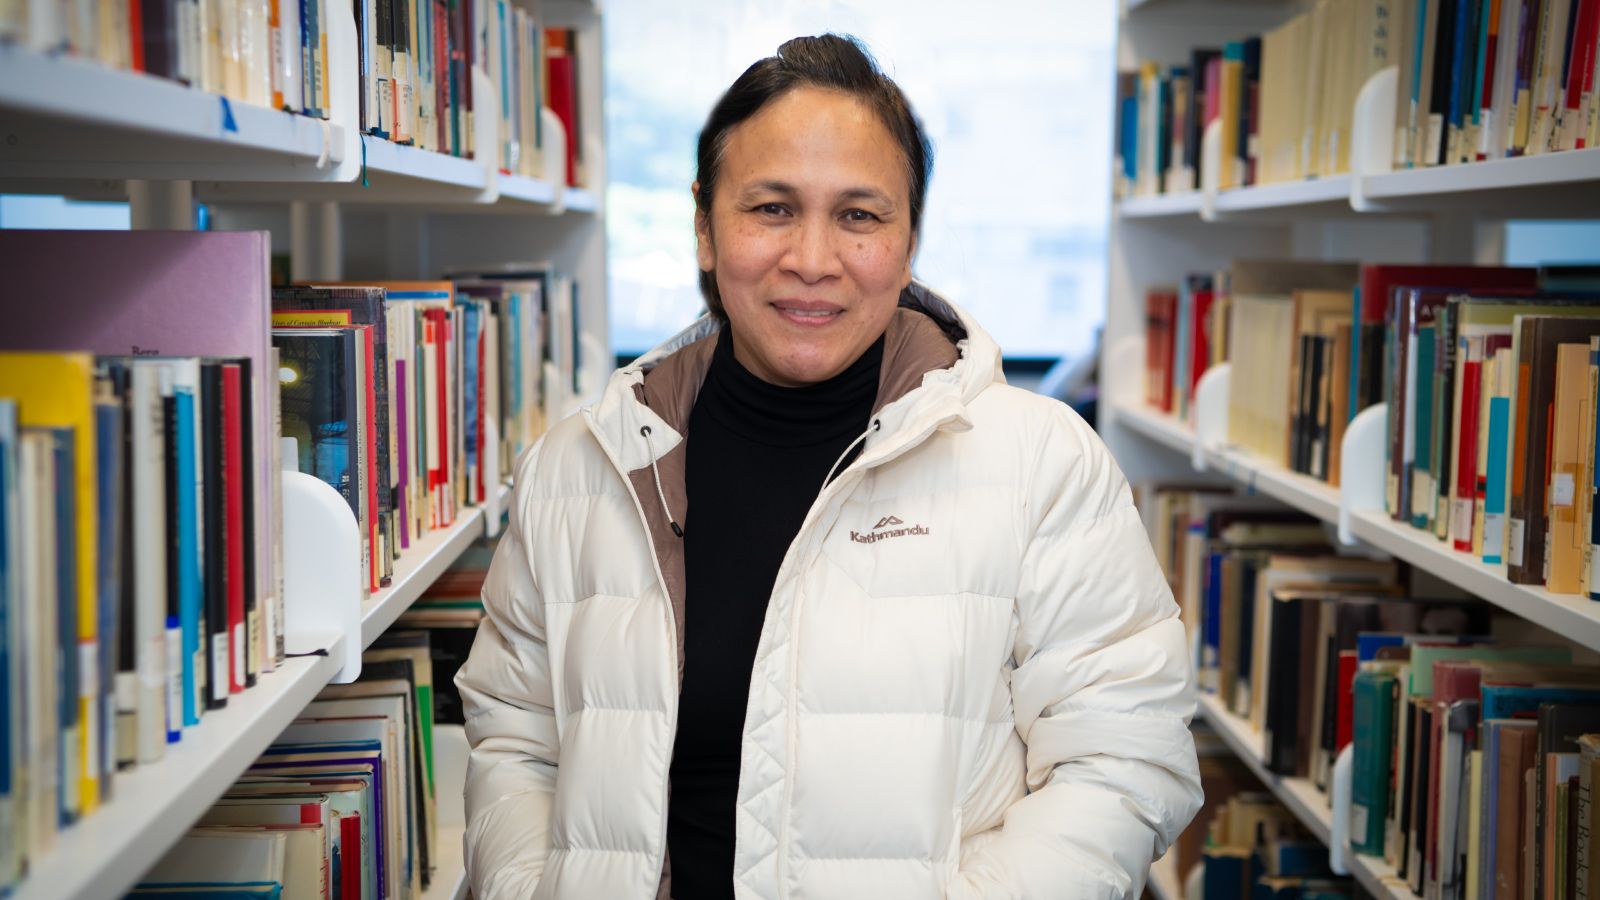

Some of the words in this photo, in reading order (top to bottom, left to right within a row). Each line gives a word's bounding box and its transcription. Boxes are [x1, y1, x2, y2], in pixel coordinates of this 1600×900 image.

[850, 524, 929, 544] Kathmandu
[1578, 784, 1591, 820] The
[1576, 825, 1591, 872] Book
